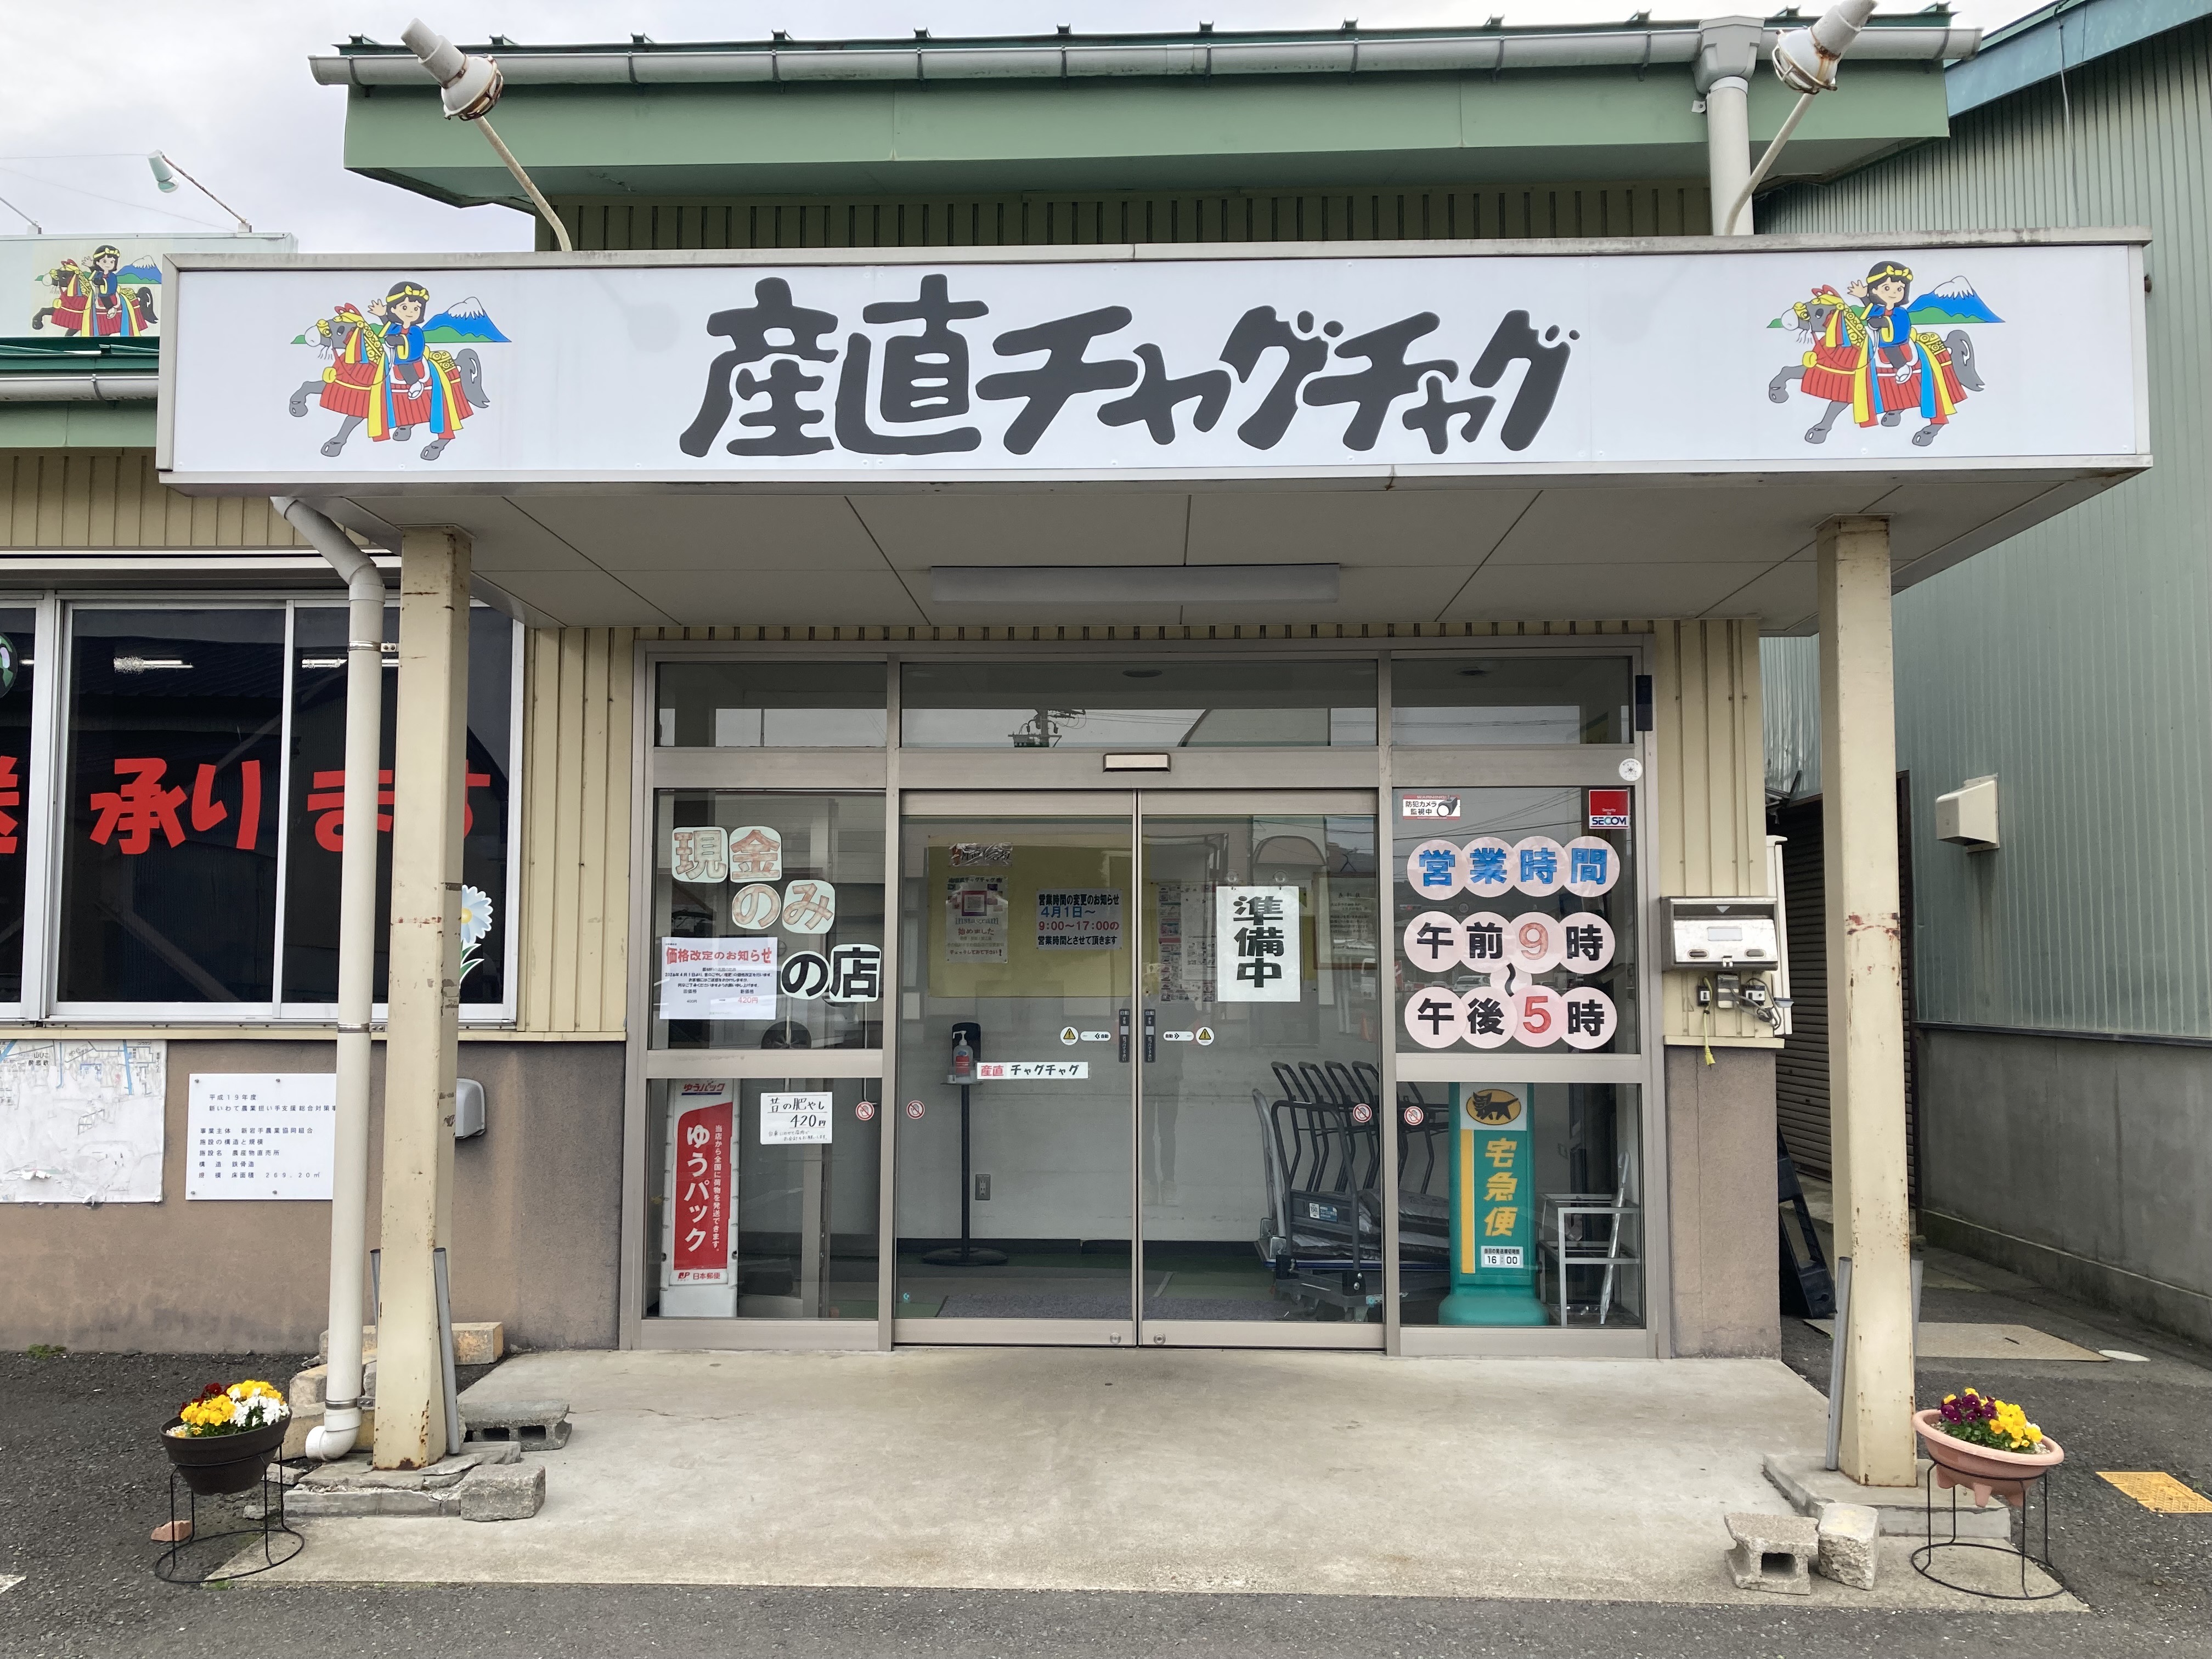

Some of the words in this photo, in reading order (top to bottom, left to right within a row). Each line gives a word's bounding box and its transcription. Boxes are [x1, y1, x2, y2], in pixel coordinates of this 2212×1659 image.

[679, 274, 1580, 456] 産直チャグチャグ
[1592, 817, 1627, 825] SECOM
[674, 829, 781, 880] 現金
[1419, 847, 1608, 887] 営業時間
[732, 883, 833, 930] のみ
[1039, 894, 1119, 906] 営業時間の変更のお知らせ
[666, 946, 772, 964] 価格改定のお知らせ
[1038, 935, 1117, 945] 営業時間とさせて頂きます
[1233, 895, 1284, 988] 準備中
[1417, 922, 1603, 961] 午前9時
[782, 947, 880, 998] の店
[1417, 996, 1605, 1037] 午後5時
[981, 1065, 1005, 1076] 産直
[1010, 1064, 1080, 1076] チャグチャグ
[769, 1097, 825, 1113] 昔の肥やし
[790, 1114, 826, 1128] 420円
[684, 1124, 710, 1252] ゆうパック
[712, 1125, 723, 1252] 当店から全国に荷物を発送できます。
[1483, 1137, 1518, 1237] 宅急便
